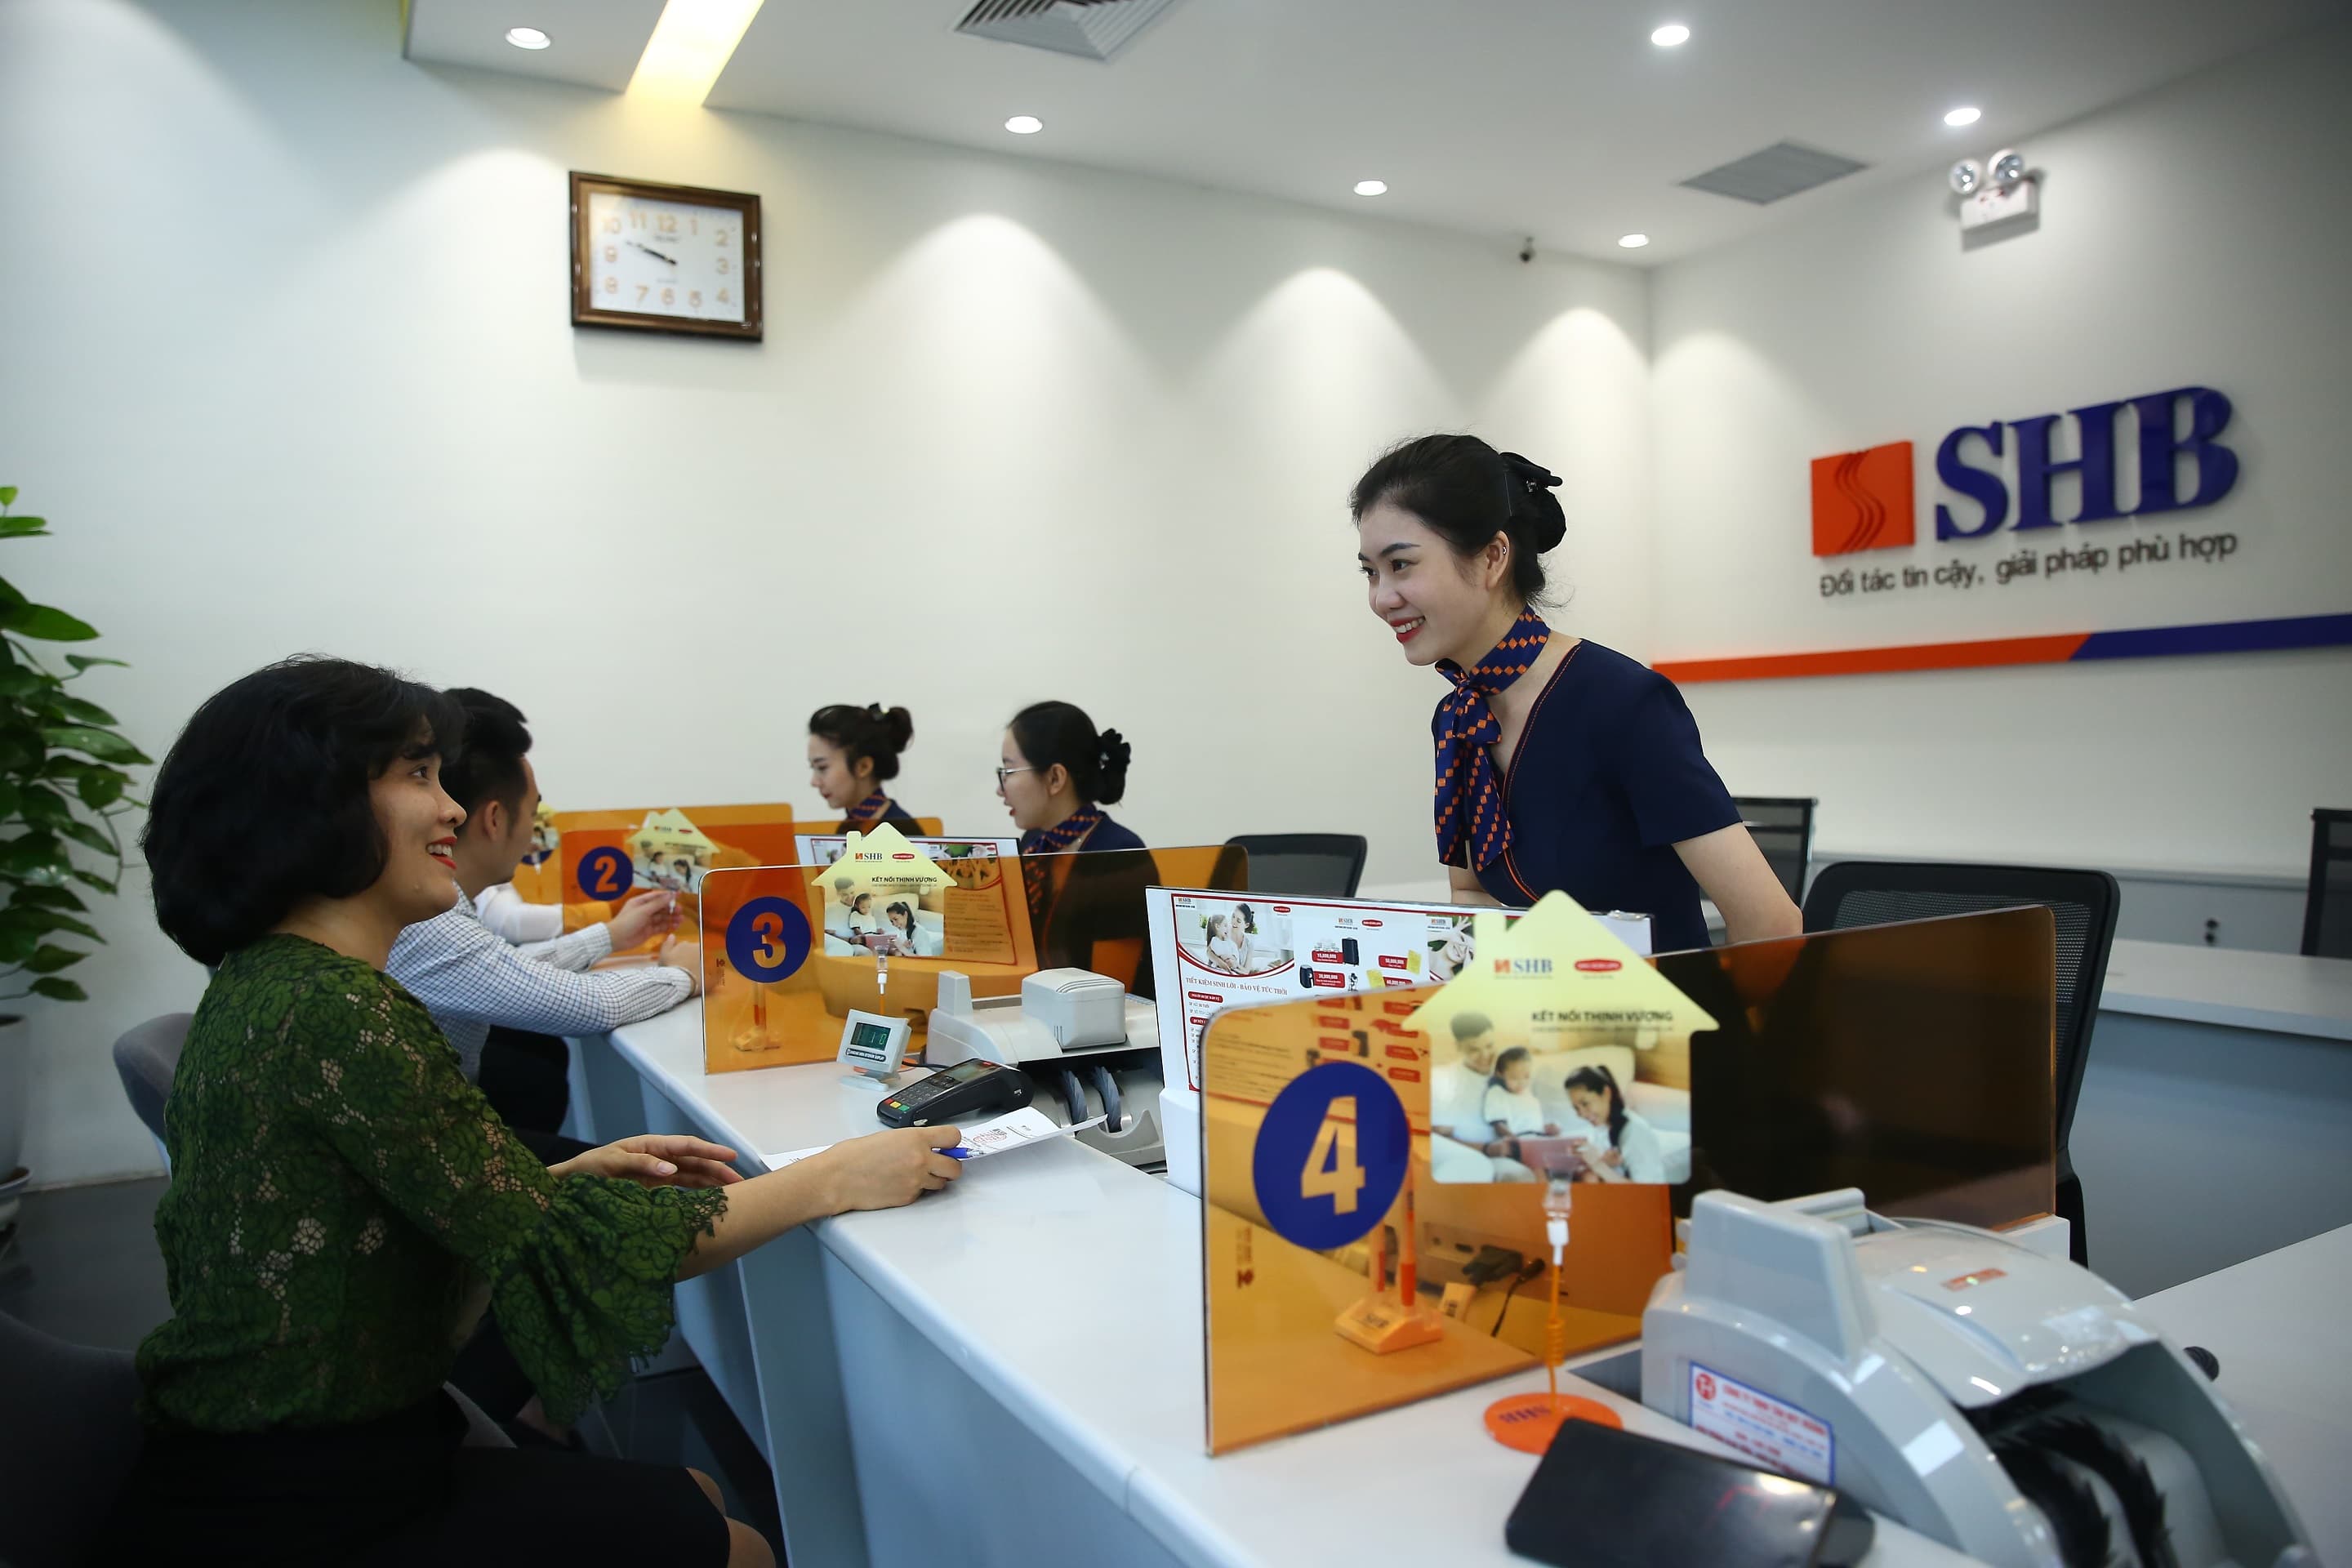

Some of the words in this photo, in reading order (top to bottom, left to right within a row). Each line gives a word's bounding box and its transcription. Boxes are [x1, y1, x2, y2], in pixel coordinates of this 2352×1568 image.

[602, 216, 622, 234] 10
[630, 212, 648, 229] 11
[657, 215, 677, 233] 12
[689, 217, 698, 235] 1
[715, 229, 728, 247] 2
[605, 247, 617, 263] 9
[715, 257, 728, 274] 3
[635, 285, 648, 303] 7
[661, 287, 675, 305] 6
[1935, 385, 2240, 542] SHB
[1820, 568, 1855, 597] Đối
[1860, 568, 1895, 593] tác
[1902, 565, 1927, 588] tin
[1995, 548, 2037, 585] giải
[2044, 542, 2109, 578] pháp
[2118, 535, 2171, 571] phù
[2178, 532, 2238, 563] hợp
[594, 856, 617, 893] 2
[752, 911, 786, 969] 3
[1513, 959, 1553, 973] SHB
[1531, 1009, 1555, 1022] KẾT
[1558, 1009, 1581, 1022] NỐI
[1301, 1095, 1366, 1216] 4
